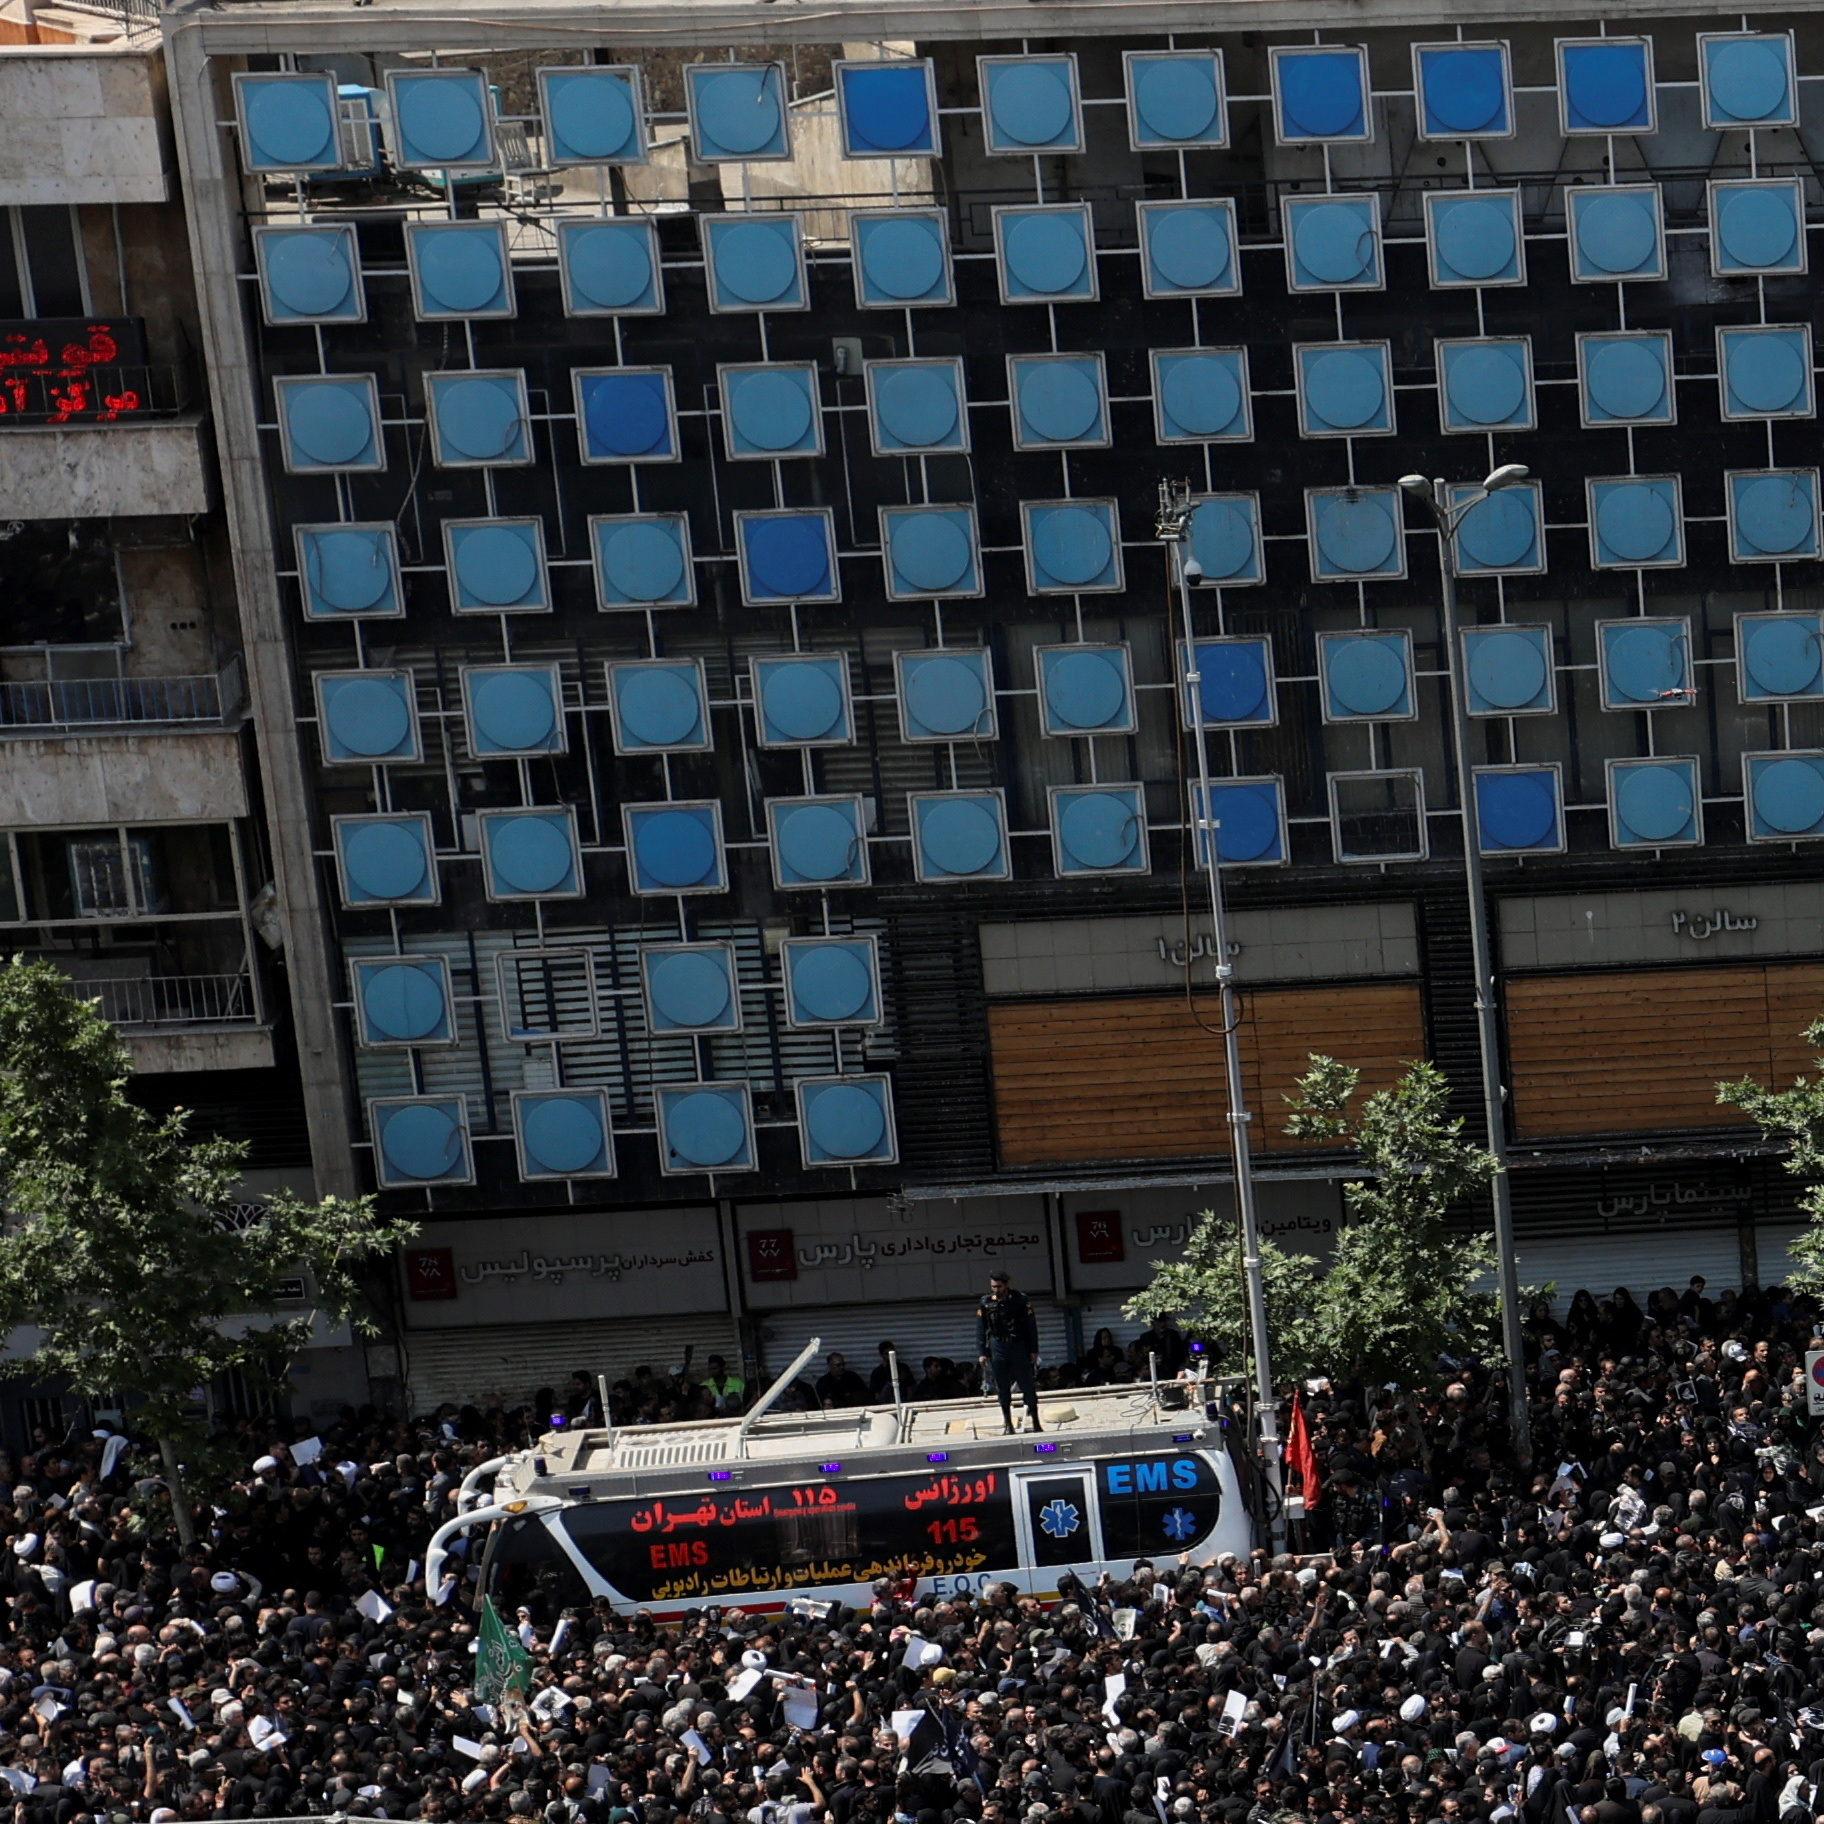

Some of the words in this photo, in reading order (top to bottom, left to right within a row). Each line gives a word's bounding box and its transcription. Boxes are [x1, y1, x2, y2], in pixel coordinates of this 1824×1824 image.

[1671, 911, 1686, 933] ۲
[1689, 909, 1758, 939] سالن
[1597, 1183, 1671, 1223] پارس
[1673, 1181, 1752, 1213] سینما
[1091, 1221, 1107, 1230] 76
[1133, 1214, 1195, 1247] ارس
[759, 1239, 778, 1248] 77
[799, 1234, 877, 1269] پارس
[881, 1236, 929, 1256] اداری
[931, 1235, 982, 1254] تجاری
[981, 1232, 1040, 1256] مجتمع
[417, 1257, 439, 1267] 78
[461, 1250, 621, 1285] پرسپولیس
[620, 1253, 677, 1271] سرداران
[678, 1250, 715, 1266] کفش
[904, 1469, 996, 1511] اورژانس
[1107, 1459, 1198, 1494] EMS
[792, 1486, 838, 1506] ۱۱۵
[630, 1497, 717, 1534] تهران
[719, 1496, 771, 1527] استان
[927, 1516, 980, 1545] 115
[648, 1540, 709, 1571] EMS
[942, 1551, 987, 1576] خودرو
[711, 1565, 783, 1597] ارتباطات
[793, 1561, 852, 1583] عملیات
[651, 1573, 708, 1601] رادیویی
